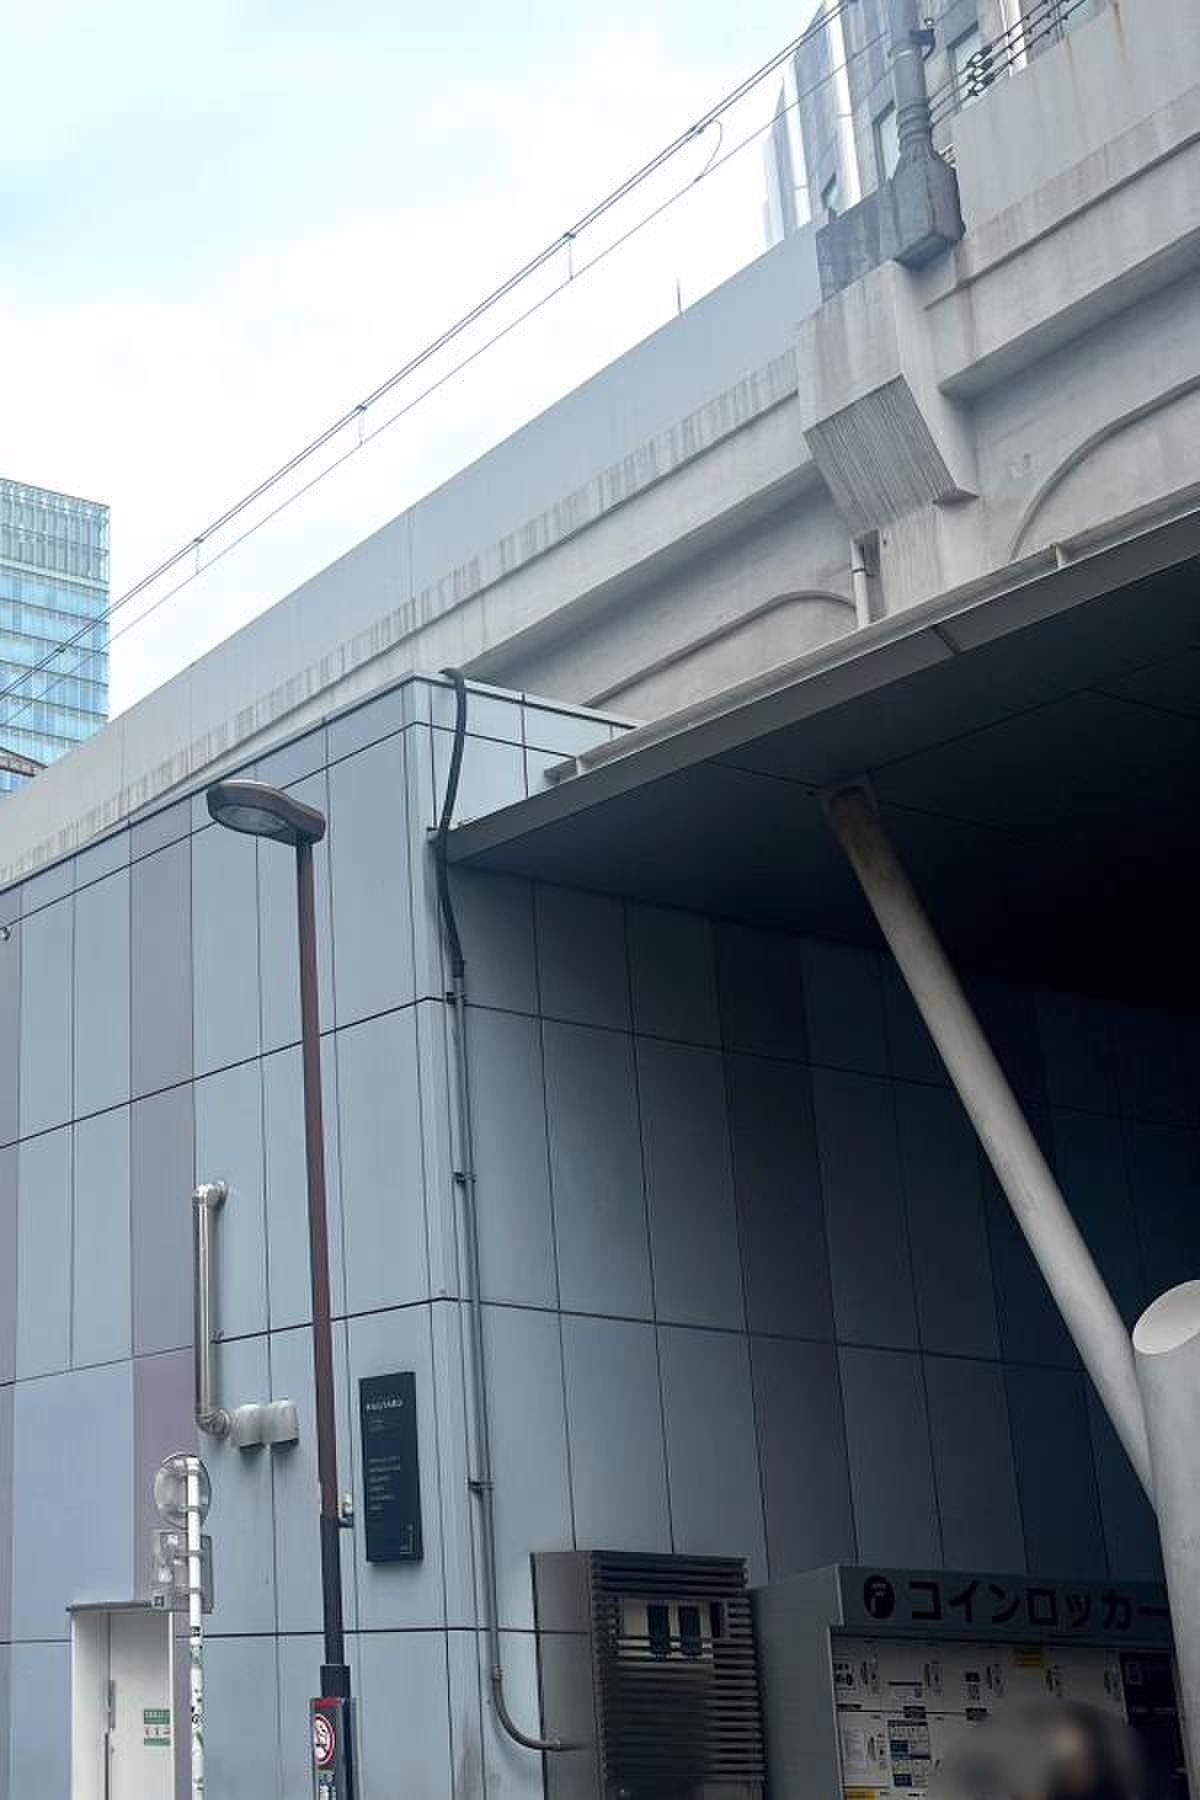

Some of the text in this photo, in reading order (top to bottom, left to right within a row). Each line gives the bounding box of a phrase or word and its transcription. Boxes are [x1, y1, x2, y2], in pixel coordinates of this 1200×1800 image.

[908, 1579, 1170, 1630] コインロッカー
